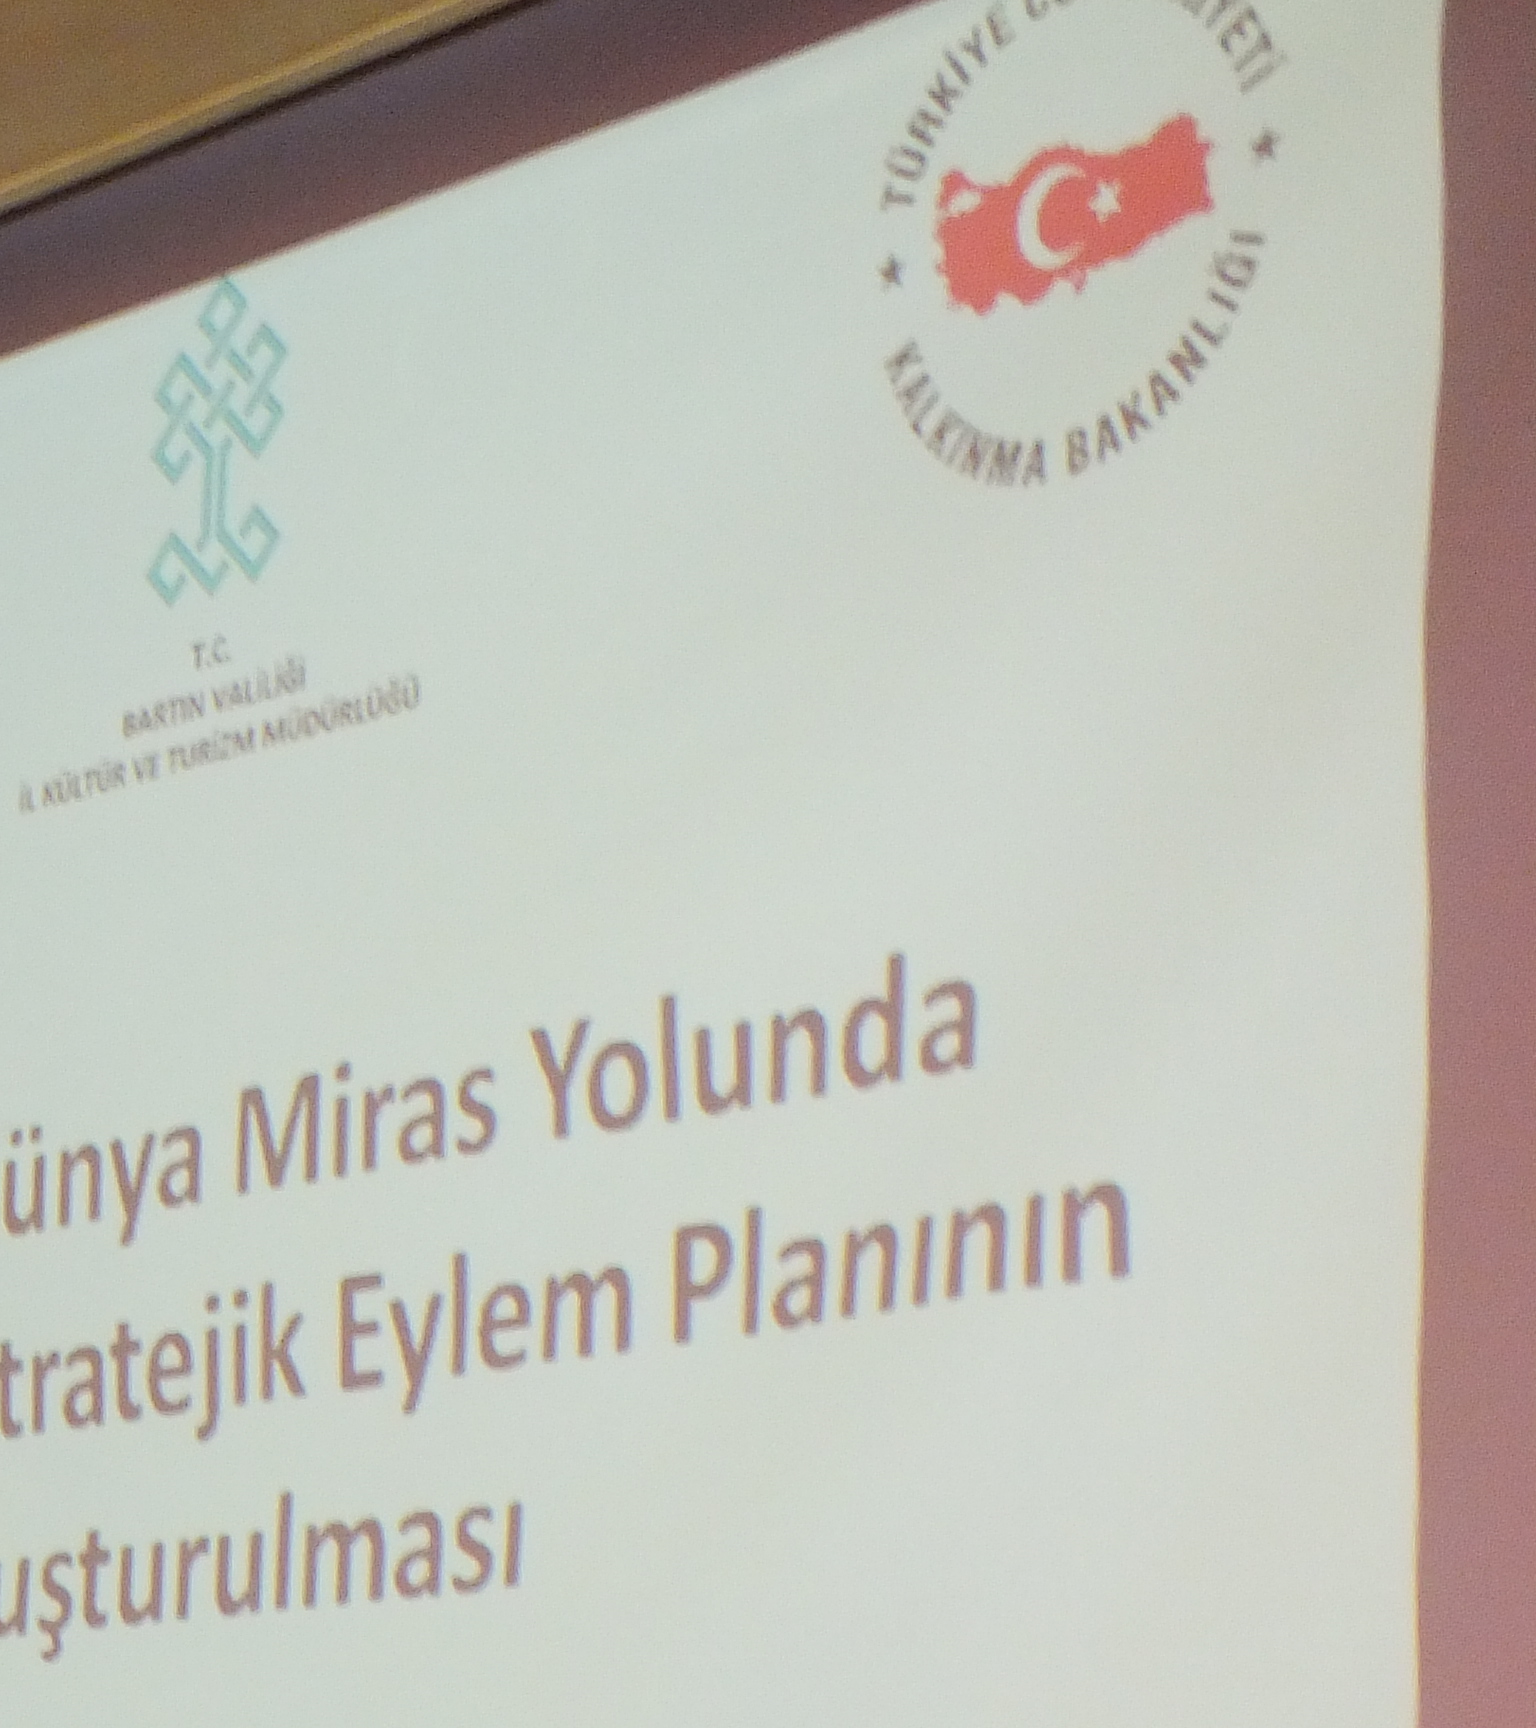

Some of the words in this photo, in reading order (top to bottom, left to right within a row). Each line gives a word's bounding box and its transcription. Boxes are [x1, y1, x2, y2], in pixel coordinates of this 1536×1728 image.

[885, 340, 1047, 486] KALKINMA
[235, 1062, 499, 1196] Miras
[530, 952, 978, 1140] Yolunda
[338, 1251, 633, 1416] Eylem
[672, 1179, 1132, 1346] Planının
